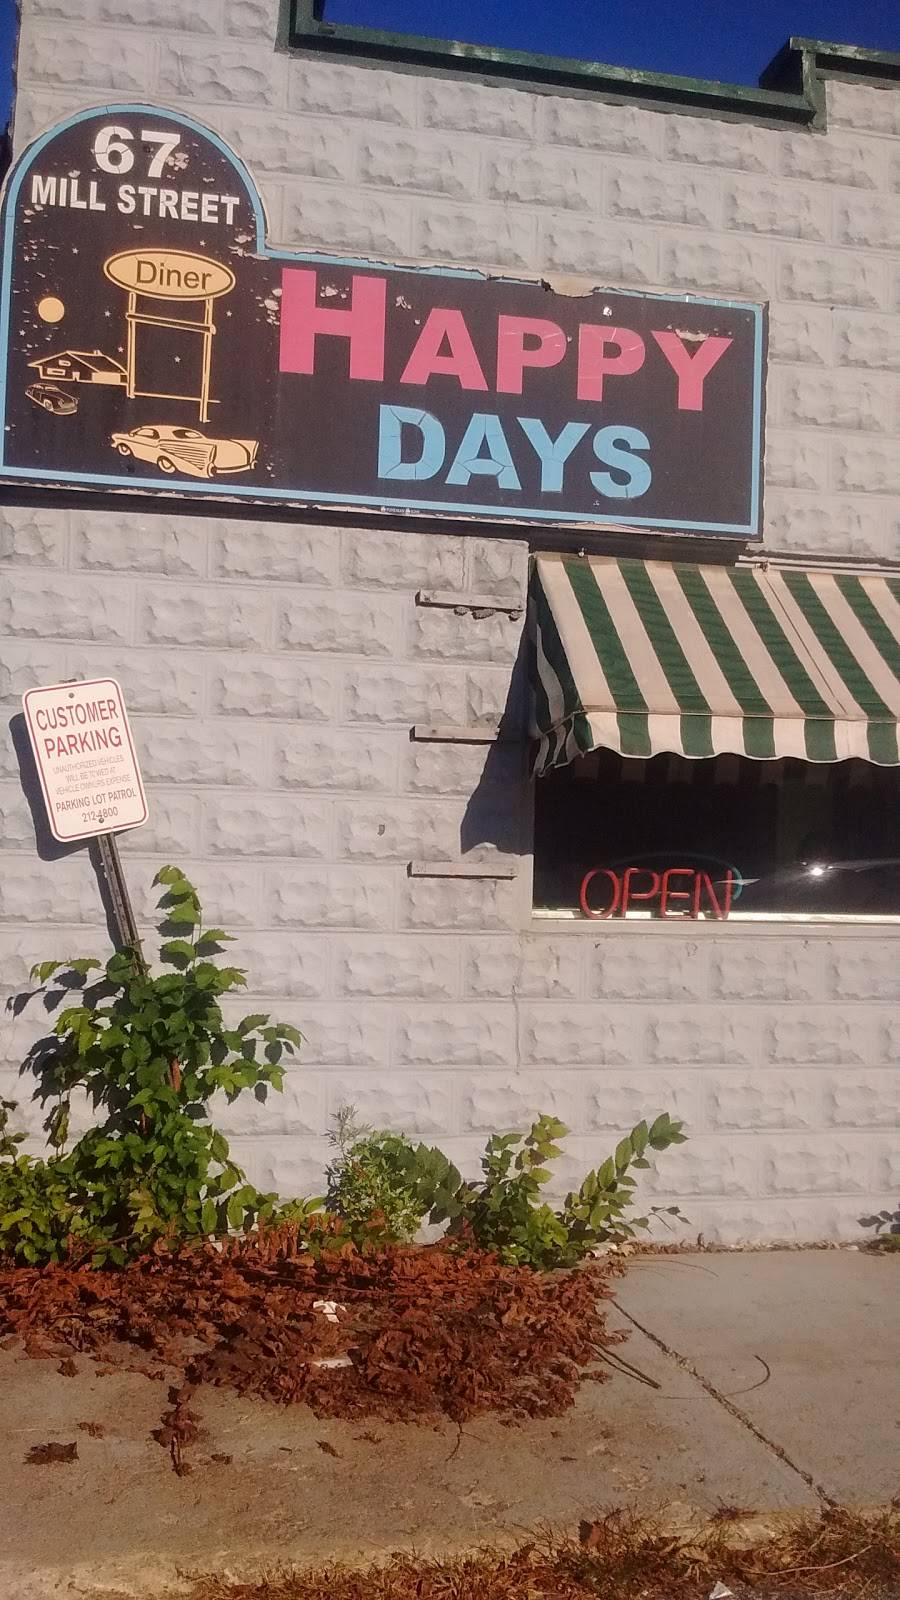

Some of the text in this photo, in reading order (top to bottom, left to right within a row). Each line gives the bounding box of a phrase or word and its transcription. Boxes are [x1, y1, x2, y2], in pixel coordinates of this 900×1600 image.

[94, 126, 181, 178] 67
[31, 174, 240, 225] MILL STREET
[136, 260, 213, 290] Diner
[279, 268, 734, 411] HAPPY
[377, 404, 653, 499] DAYS
[36, 699, 119, 731] CUSTOMER
[44, 726, 122, 759] PARKING
[53, 754, 125, 774] UNAUTHORIZED VEHICLES
[65, 773, 80, 783] WILL
[80, 772, 89, 780] BE
[56, 787, 137, 812] PARKING LOT PATROL
[82, 806, 119, 823] 212-4800
[579, 867, 733, 920] OPEN
